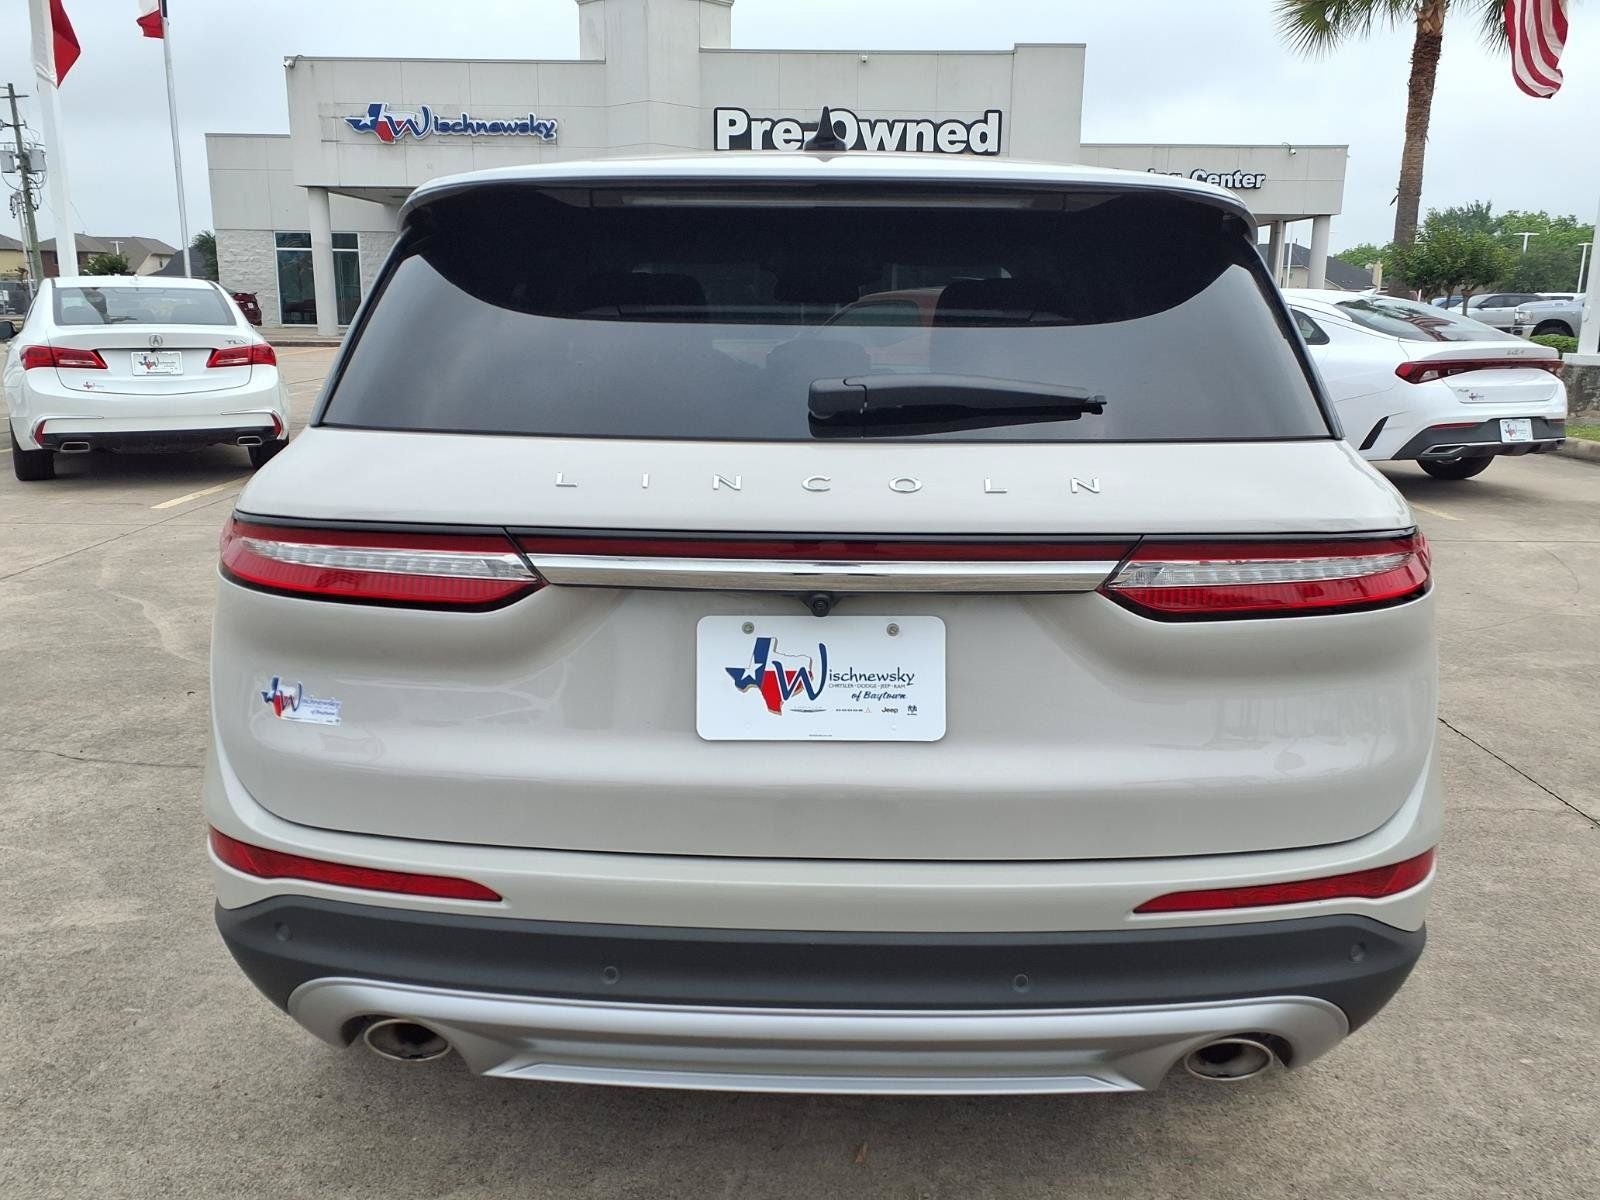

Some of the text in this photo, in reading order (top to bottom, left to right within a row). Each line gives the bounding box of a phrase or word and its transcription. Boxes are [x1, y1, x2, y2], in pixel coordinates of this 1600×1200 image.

[384, 104, 557, 141] Wischnewsky
[714, 107, 1002, 155] Pre-Owned
[1190, 169, 1266, 189] Center
[555, 471, 1100, 494] LINCOLN
[851, 691, 906, 702] of Baytown
